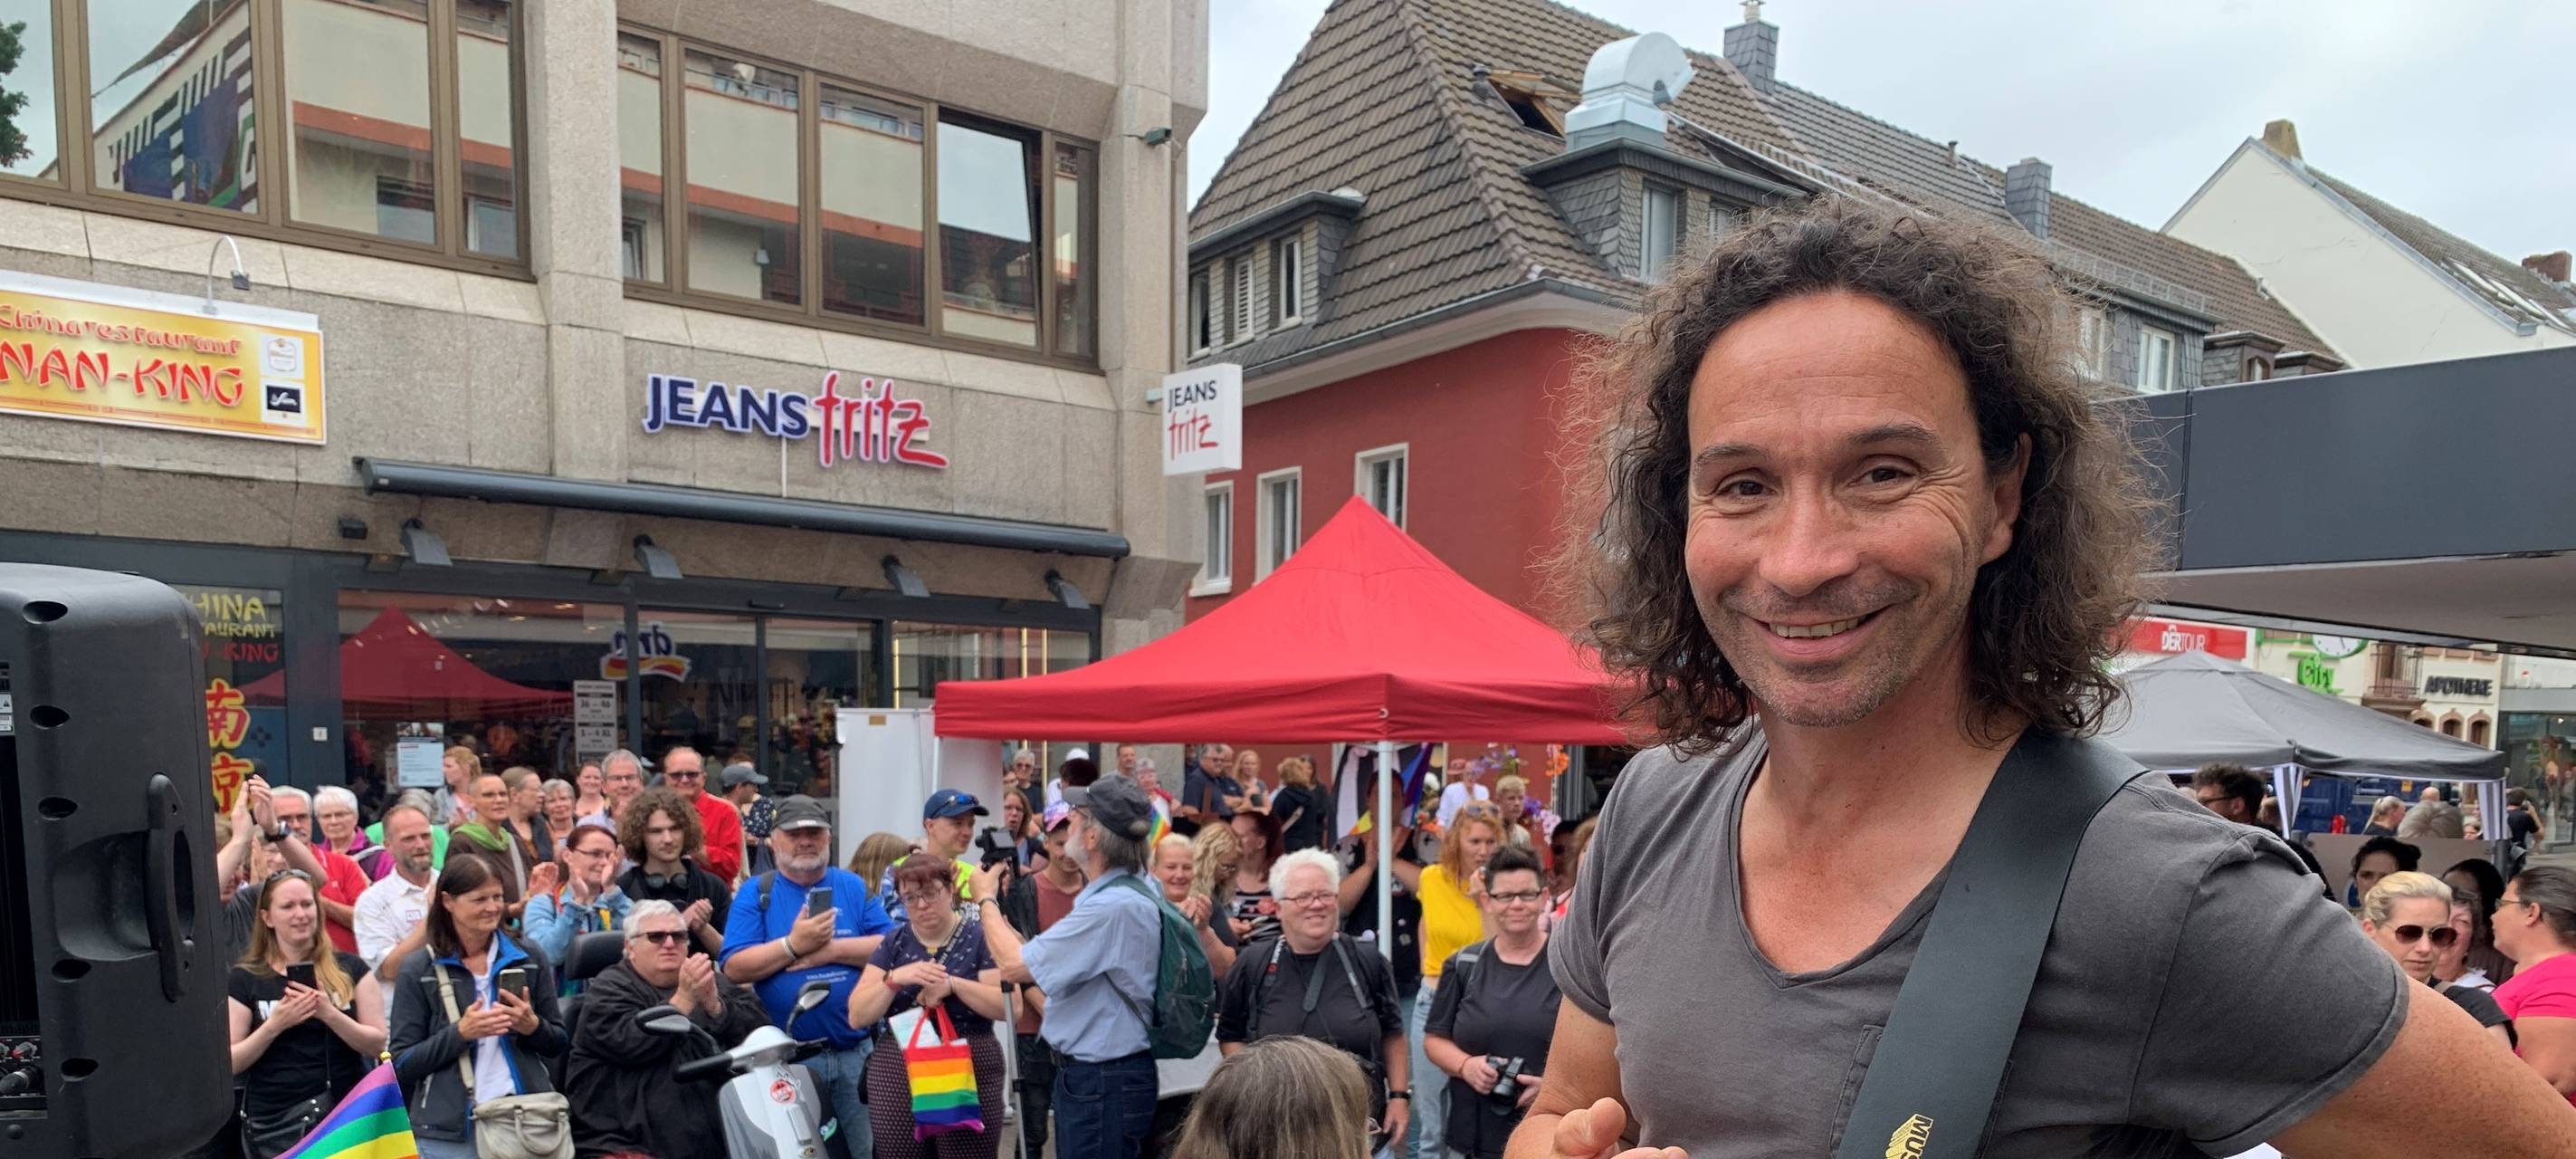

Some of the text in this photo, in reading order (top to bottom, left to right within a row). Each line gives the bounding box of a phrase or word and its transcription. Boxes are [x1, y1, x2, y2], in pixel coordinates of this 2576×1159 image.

[0, 304, 241, 356] Chinarestaurant
[0, 340, 243, 407] NAN-KING
[1168, 380, 1216, 413] JEANS
[643, 370, 949, 467] JEANS fritz
[1169, 408, 1218, 460] fritz
[189, 593, 266, 623] HINA
[2424, 675, 2494, 697] APOTHEKE
